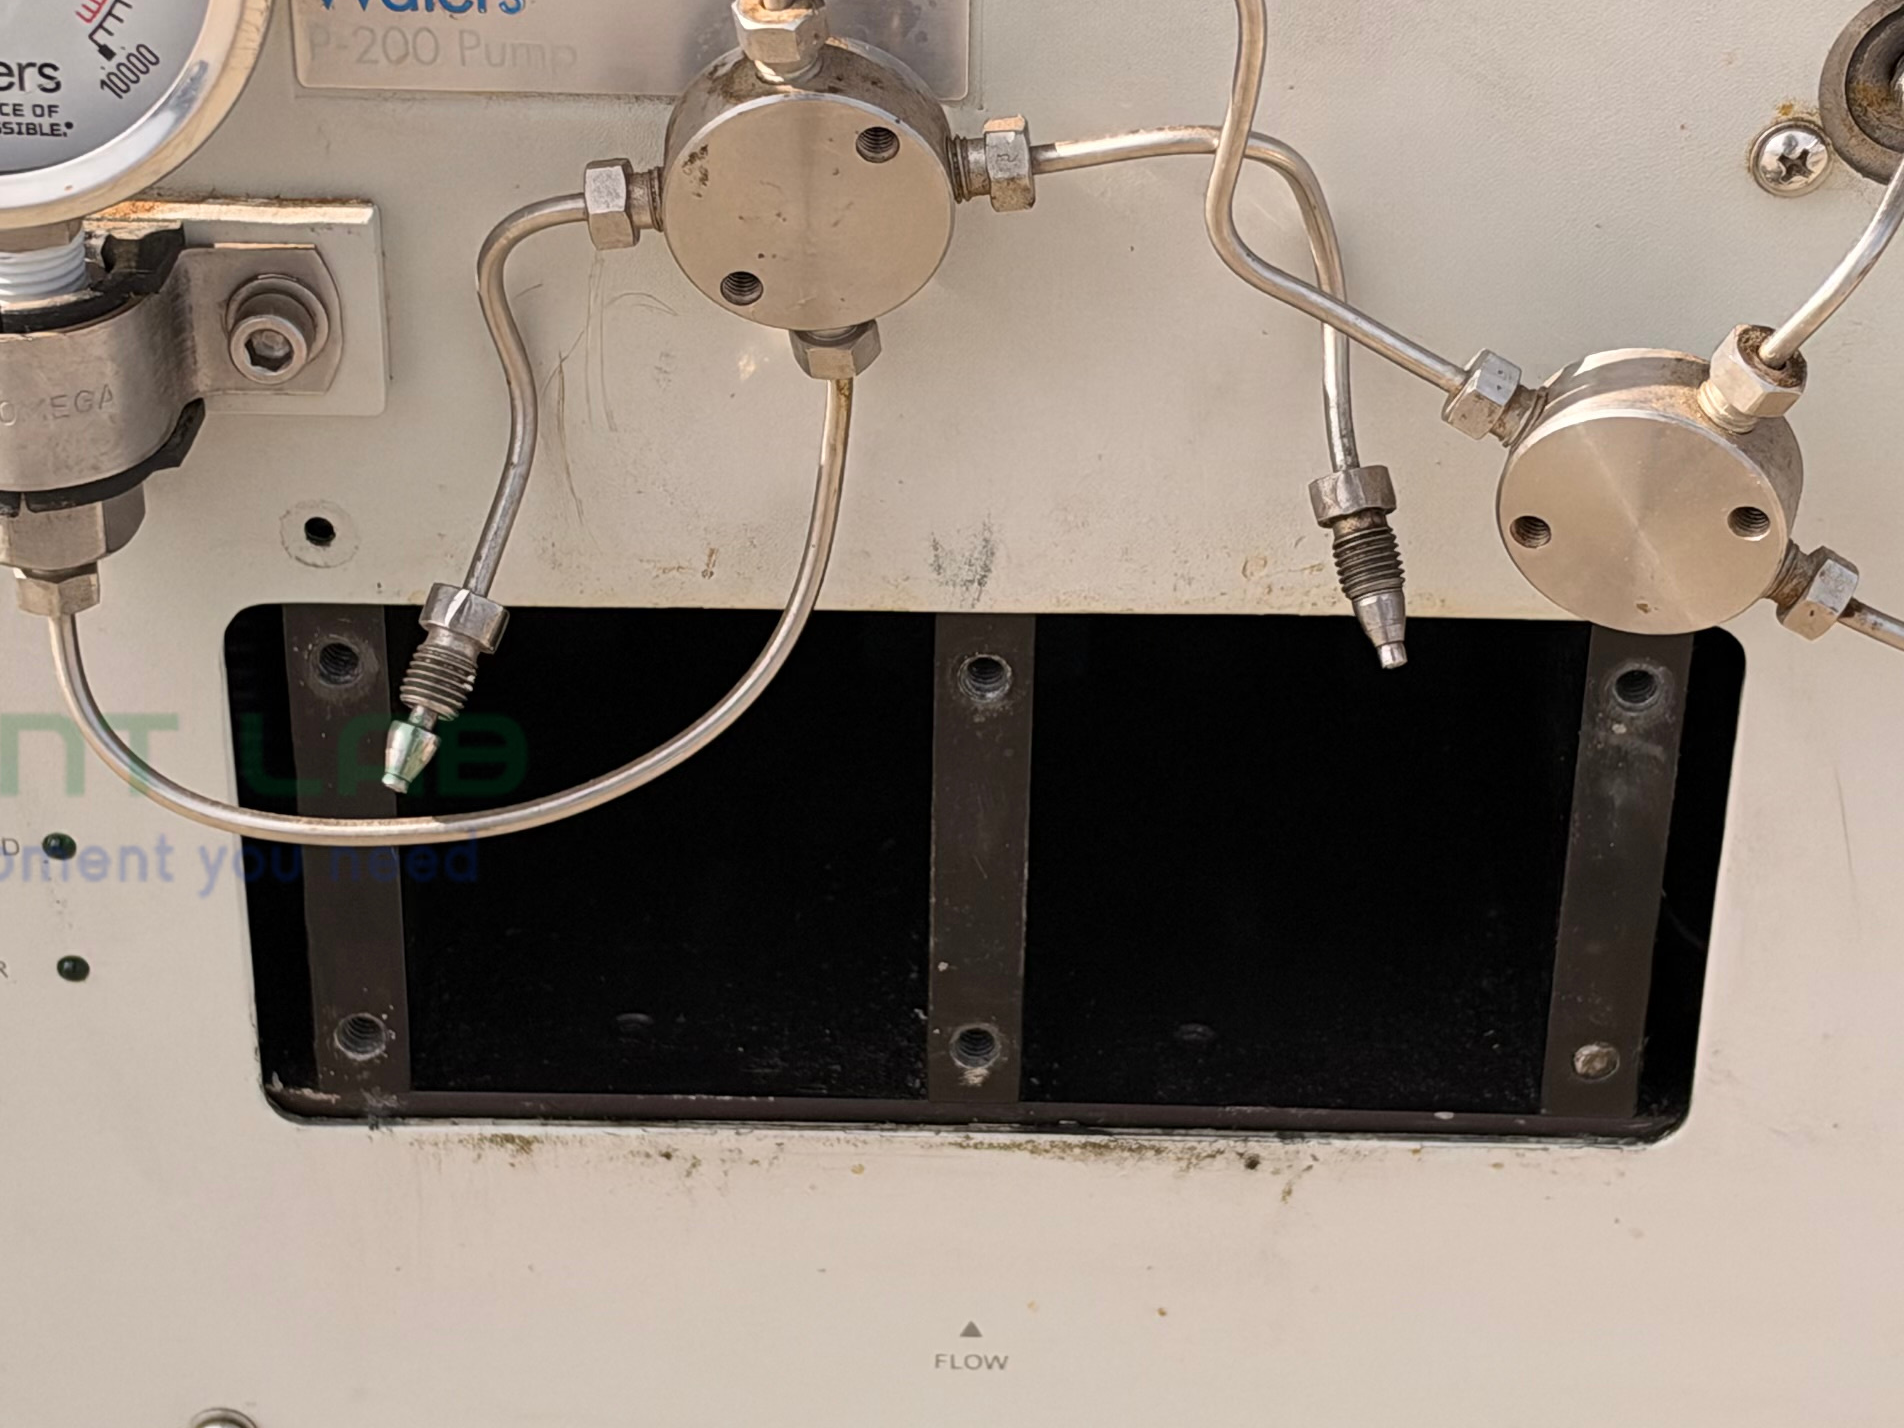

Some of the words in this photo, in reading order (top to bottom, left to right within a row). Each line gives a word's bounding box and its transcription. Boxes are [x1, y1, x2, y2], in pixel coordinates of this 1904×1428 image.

[99, 43, 160, 99] 10000
[32, 104, 59, 118] OF
[934, 1353, 1009, 1370] FLOW
